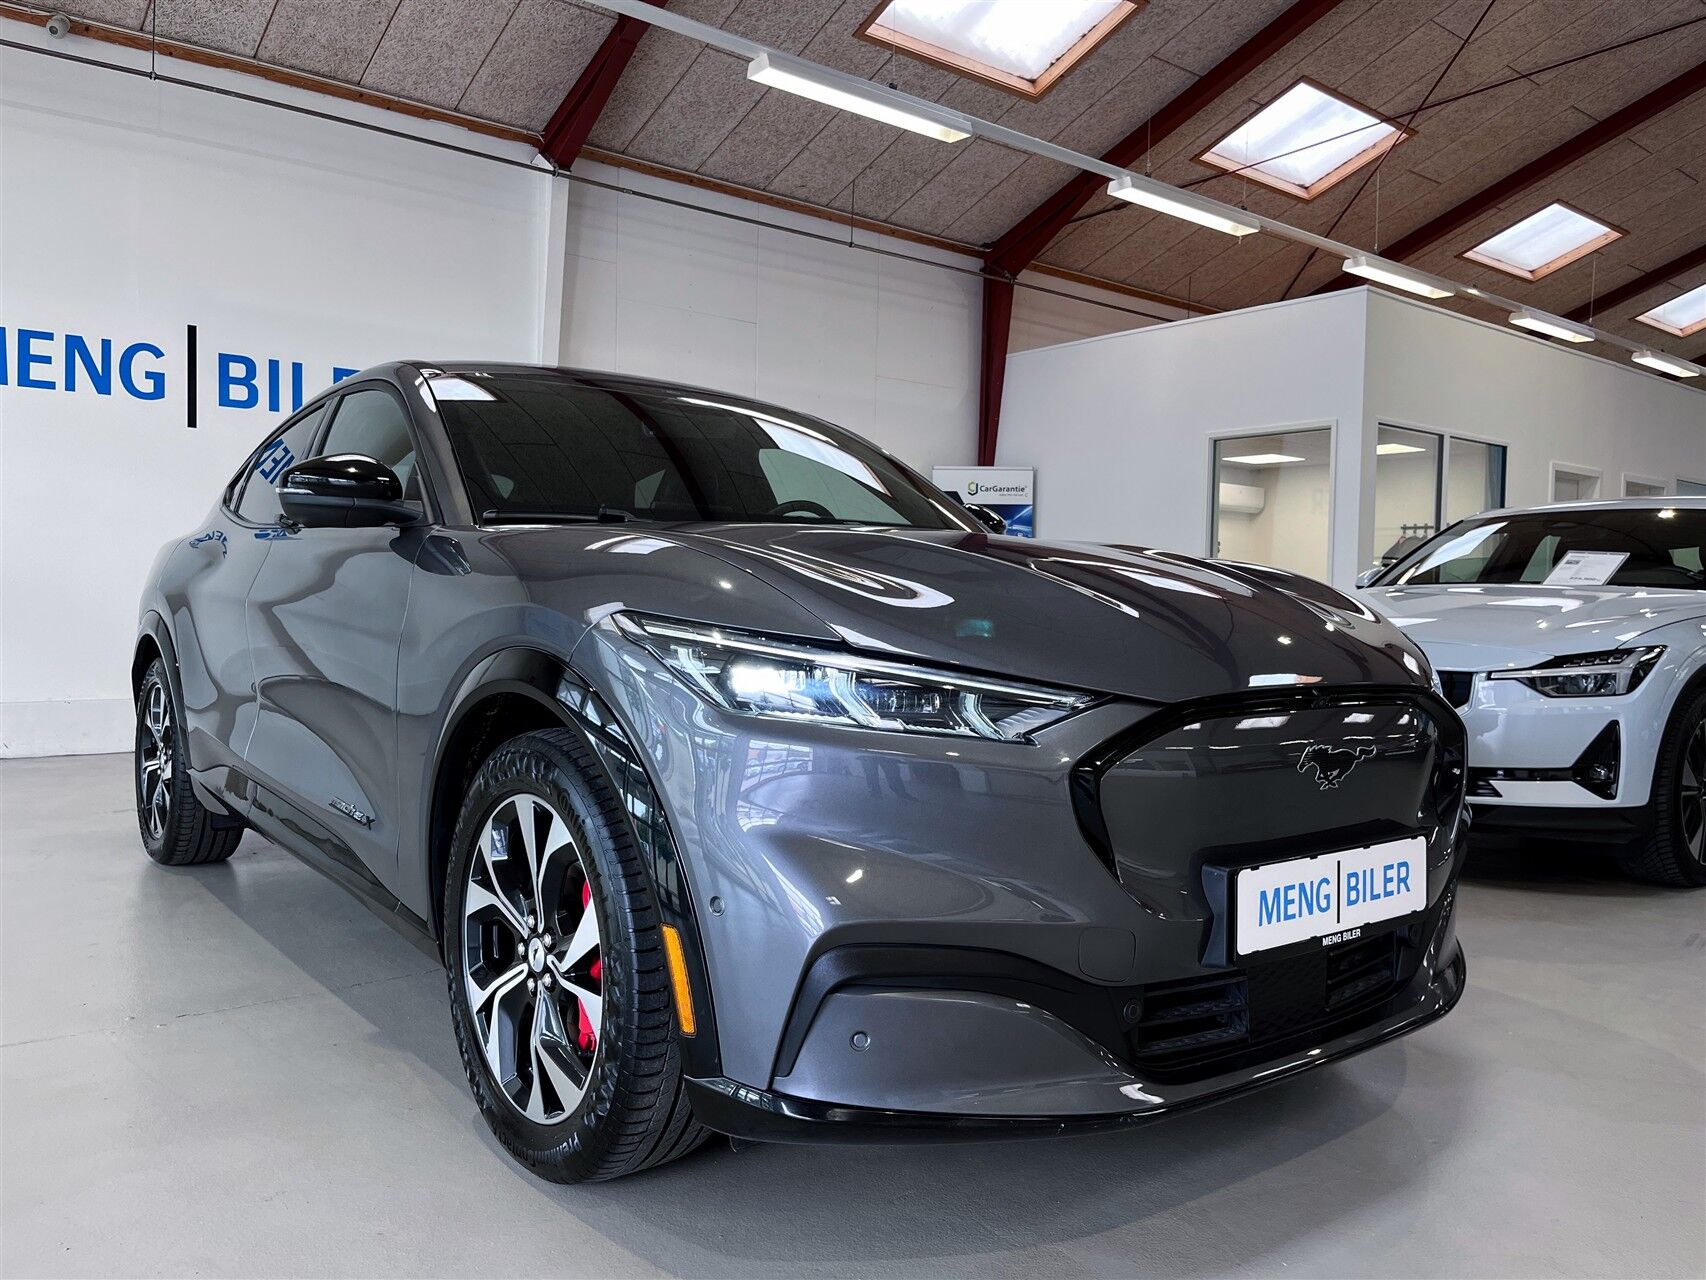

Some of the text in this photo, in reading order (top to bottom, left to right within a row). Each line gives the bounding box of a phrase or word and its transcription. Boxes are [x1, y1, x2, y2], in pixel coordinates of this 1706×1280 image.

[0, 326, 361, 413] ENG BIL
[979, 485, 1026, 493] CarGarantie
[1258, 860, 1411, 927] MENG BILER
[1322, 928, 1361, 947] MENG BILER
